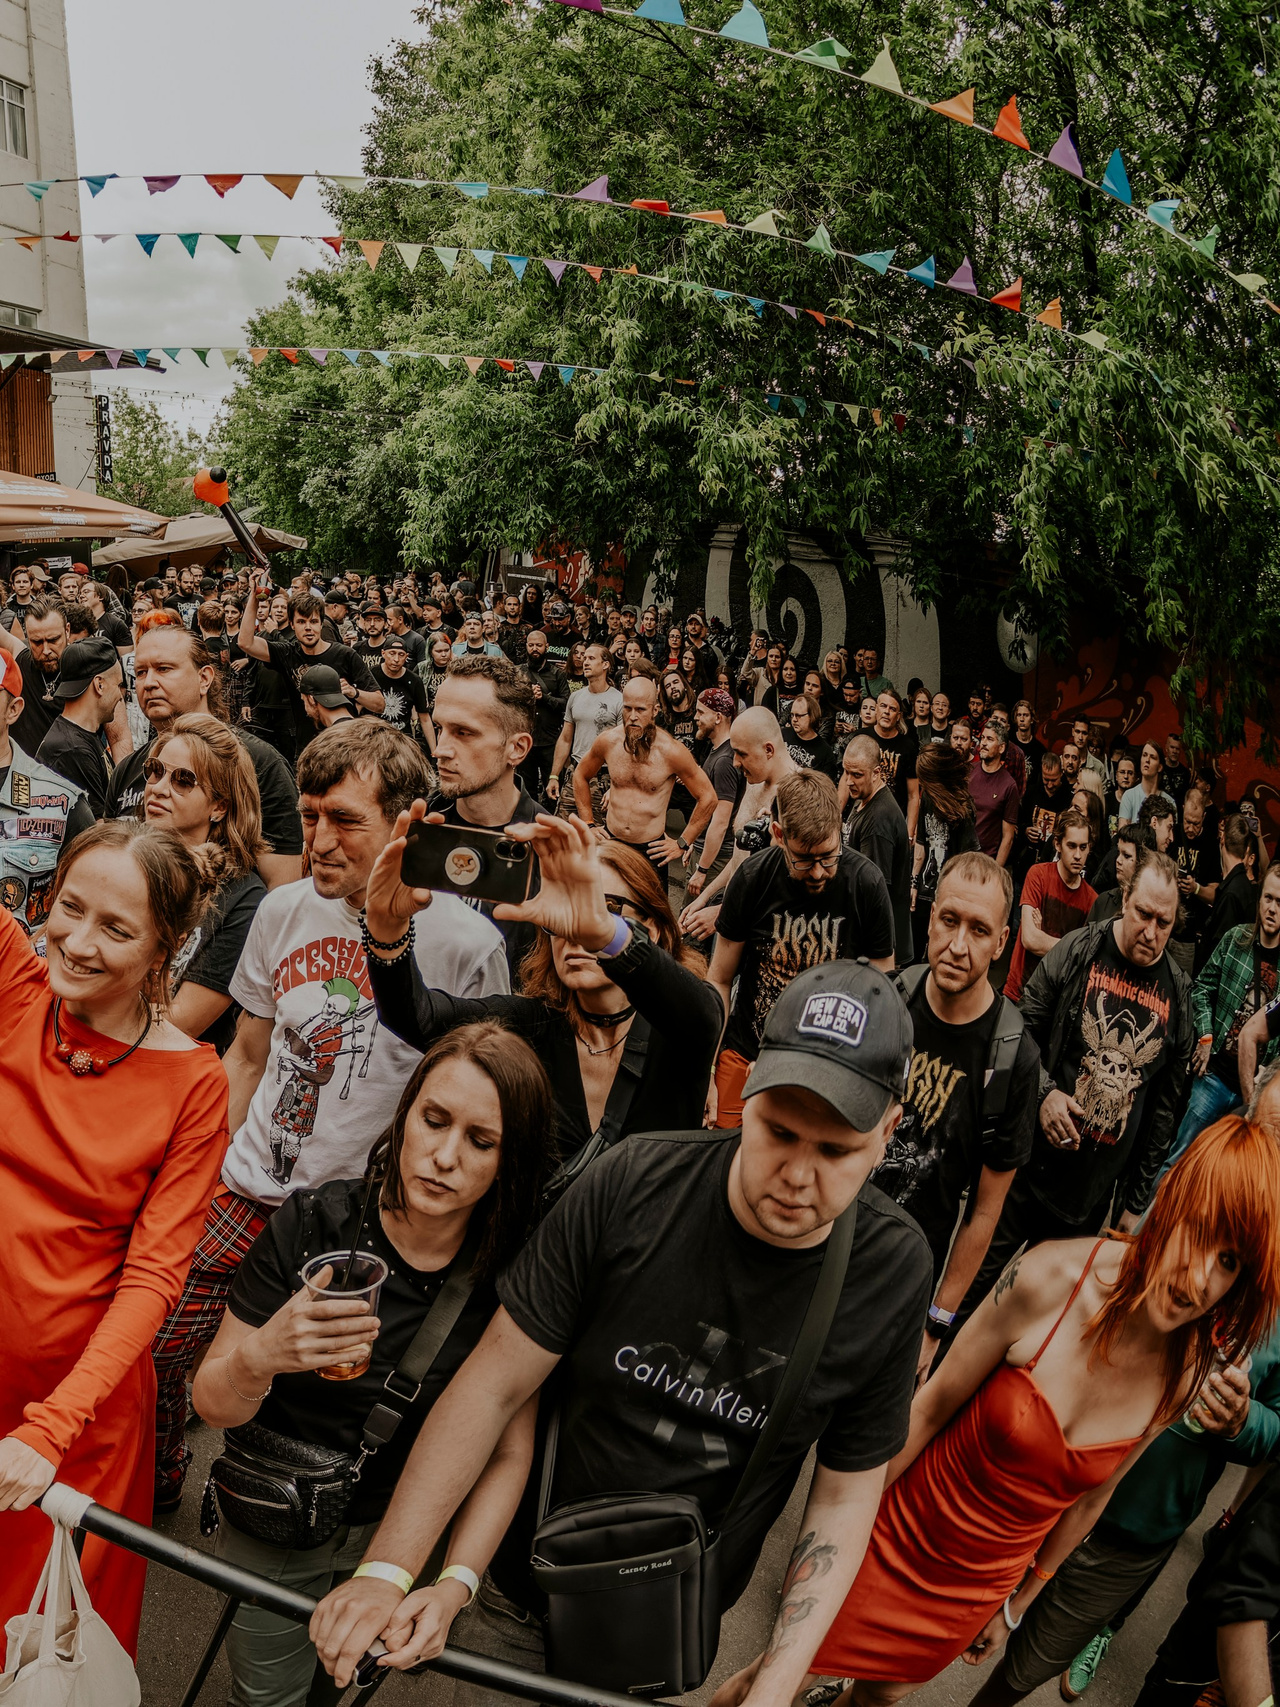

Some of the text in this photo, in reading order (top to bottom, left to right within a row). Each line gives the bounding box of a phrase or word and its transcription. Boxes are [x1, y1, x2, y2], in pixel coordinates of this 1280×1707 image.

[101, 396, 112, 481] PRAVDA
[19, 776, 28, 804] WAY
[808, 998, 861, 1028] NEW ERA
[813, 1013, 848, 1034] CAP CO.
[615, 1346, 705, 1406] Calvin
[619, 1558, 672, 1575] Carney Road
